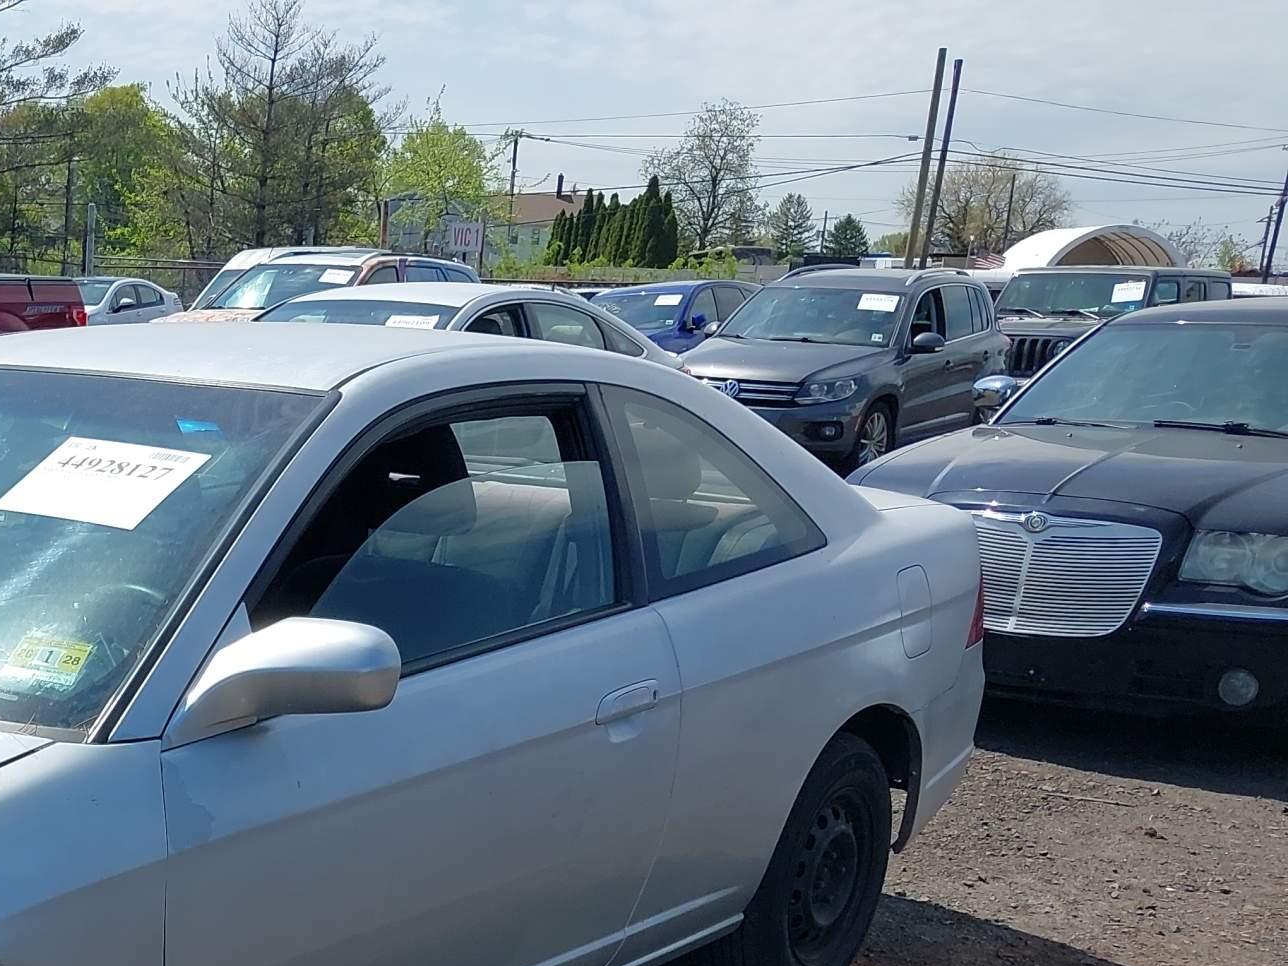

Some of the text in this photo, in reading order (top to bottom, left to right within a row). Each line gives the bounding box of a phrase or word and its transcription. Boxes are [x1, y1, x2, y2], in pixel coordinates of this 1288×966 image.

[454, 227, 480, 247] VIC 1
[57, 455, 176, 481] 44928127
[44, 650, 55, 664] 1
[62, 655, 81, 666] 28
